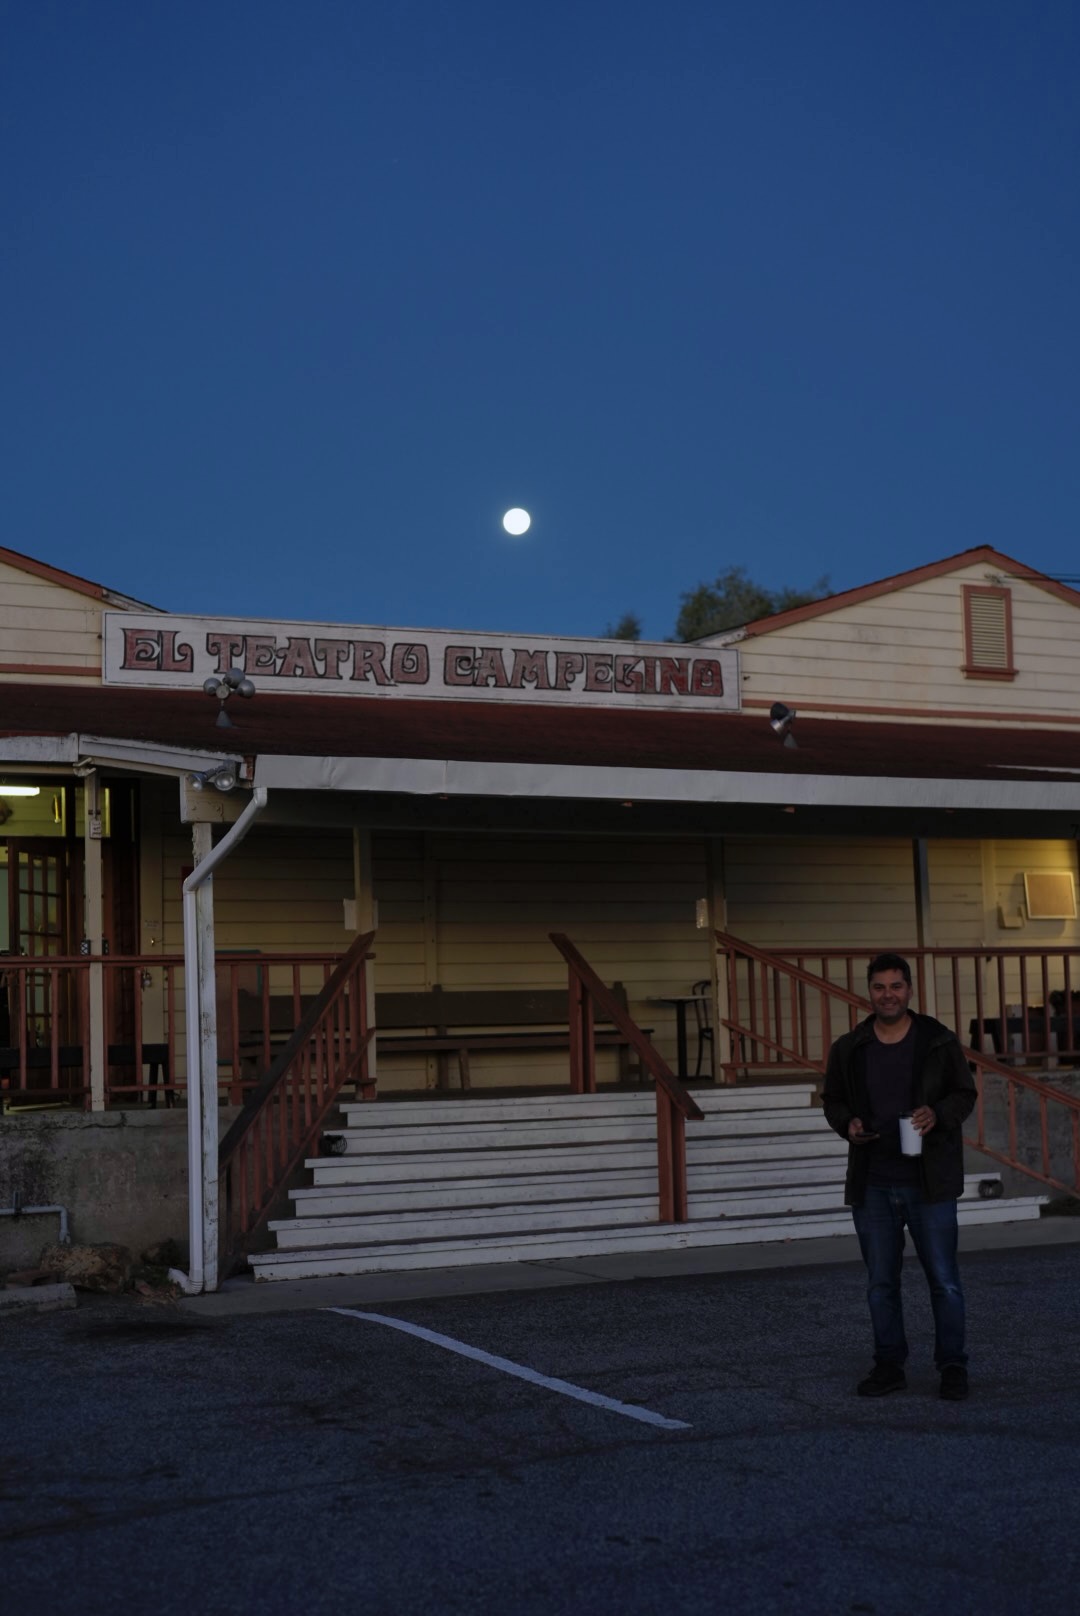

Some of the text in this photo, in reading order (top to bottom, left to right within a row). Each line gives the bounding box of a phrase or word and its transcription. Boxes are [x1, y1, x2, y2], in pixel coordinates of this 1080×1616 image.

[120, 627, 724, 697] EL TEATRO CAMPESINO
